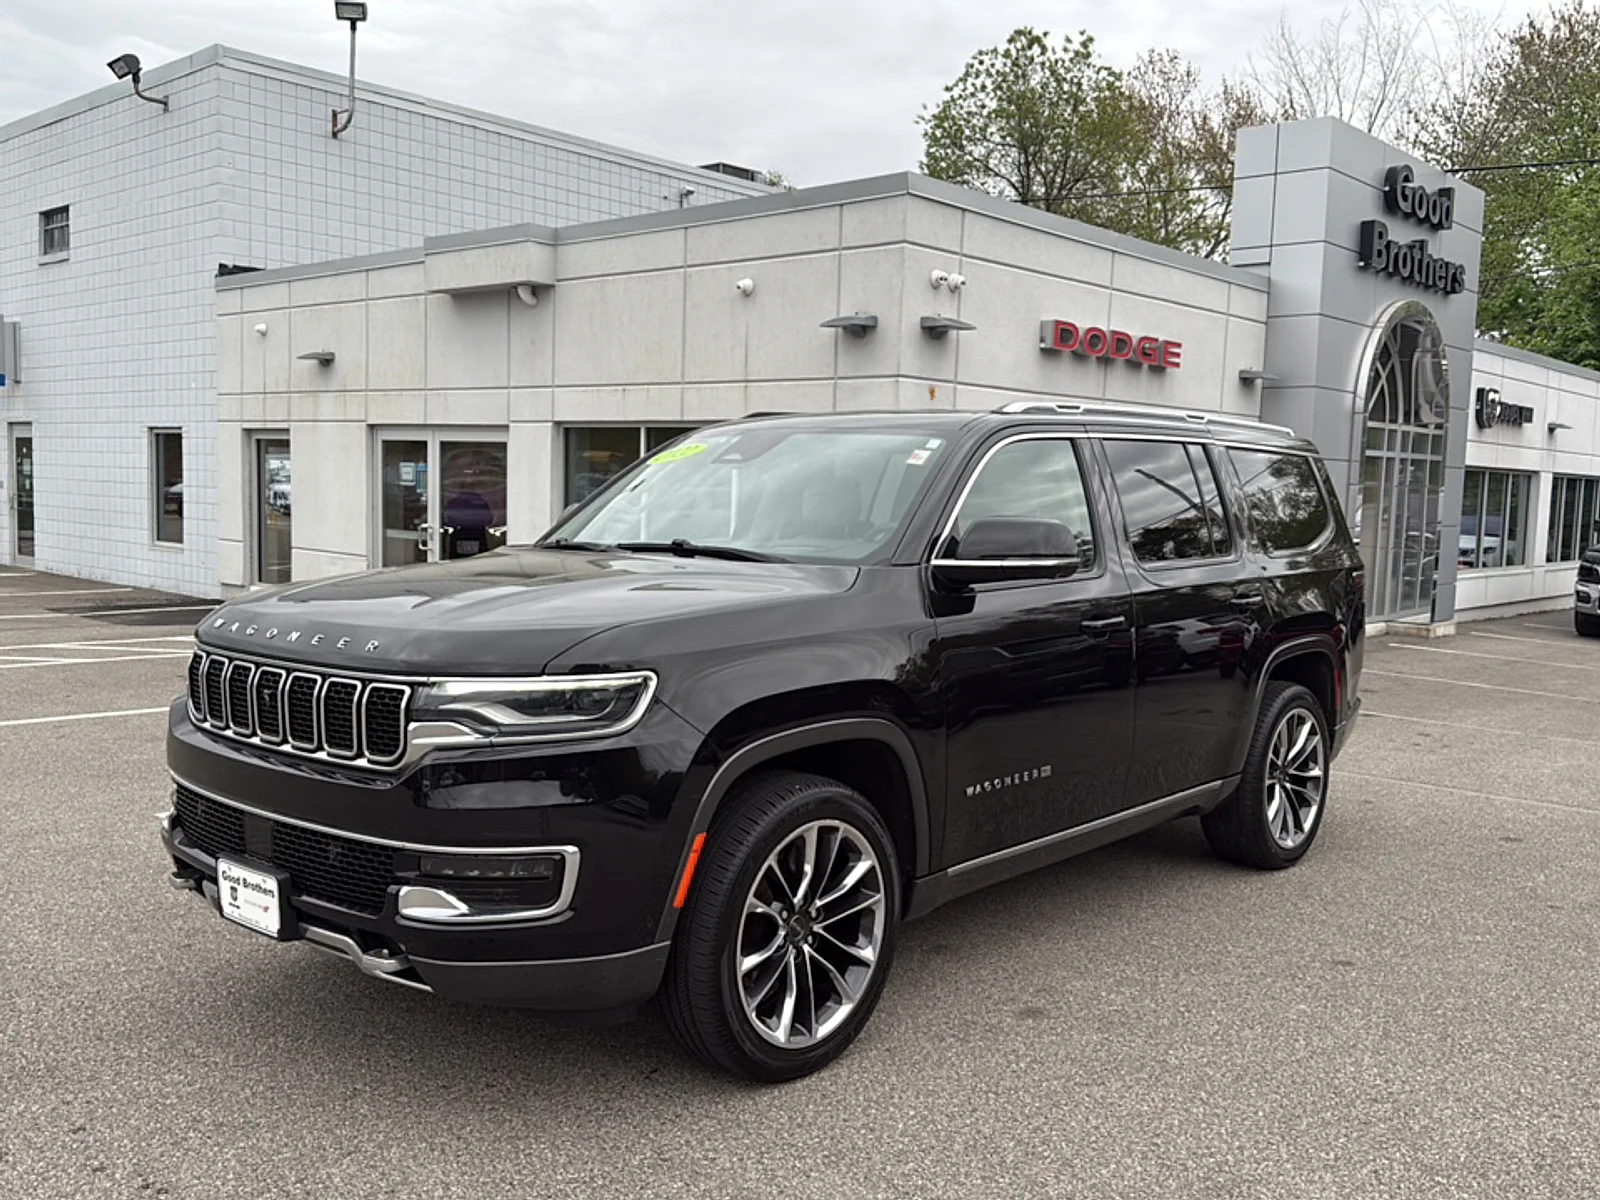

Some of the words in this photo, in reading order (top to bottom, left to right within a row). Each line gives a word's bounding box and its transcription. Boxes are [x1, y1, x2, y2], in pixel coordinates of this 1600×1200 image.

[1385, 164, 1455, 230] Good
[1360, 219, 1466, 294] Brothers
[1052, 319, 1182, 368] DODGE
[213, 618, 379, 652] WAGONEER
[964, 768, 1039, 797] WAGONEER
[222, 870, 241, 886] Good
